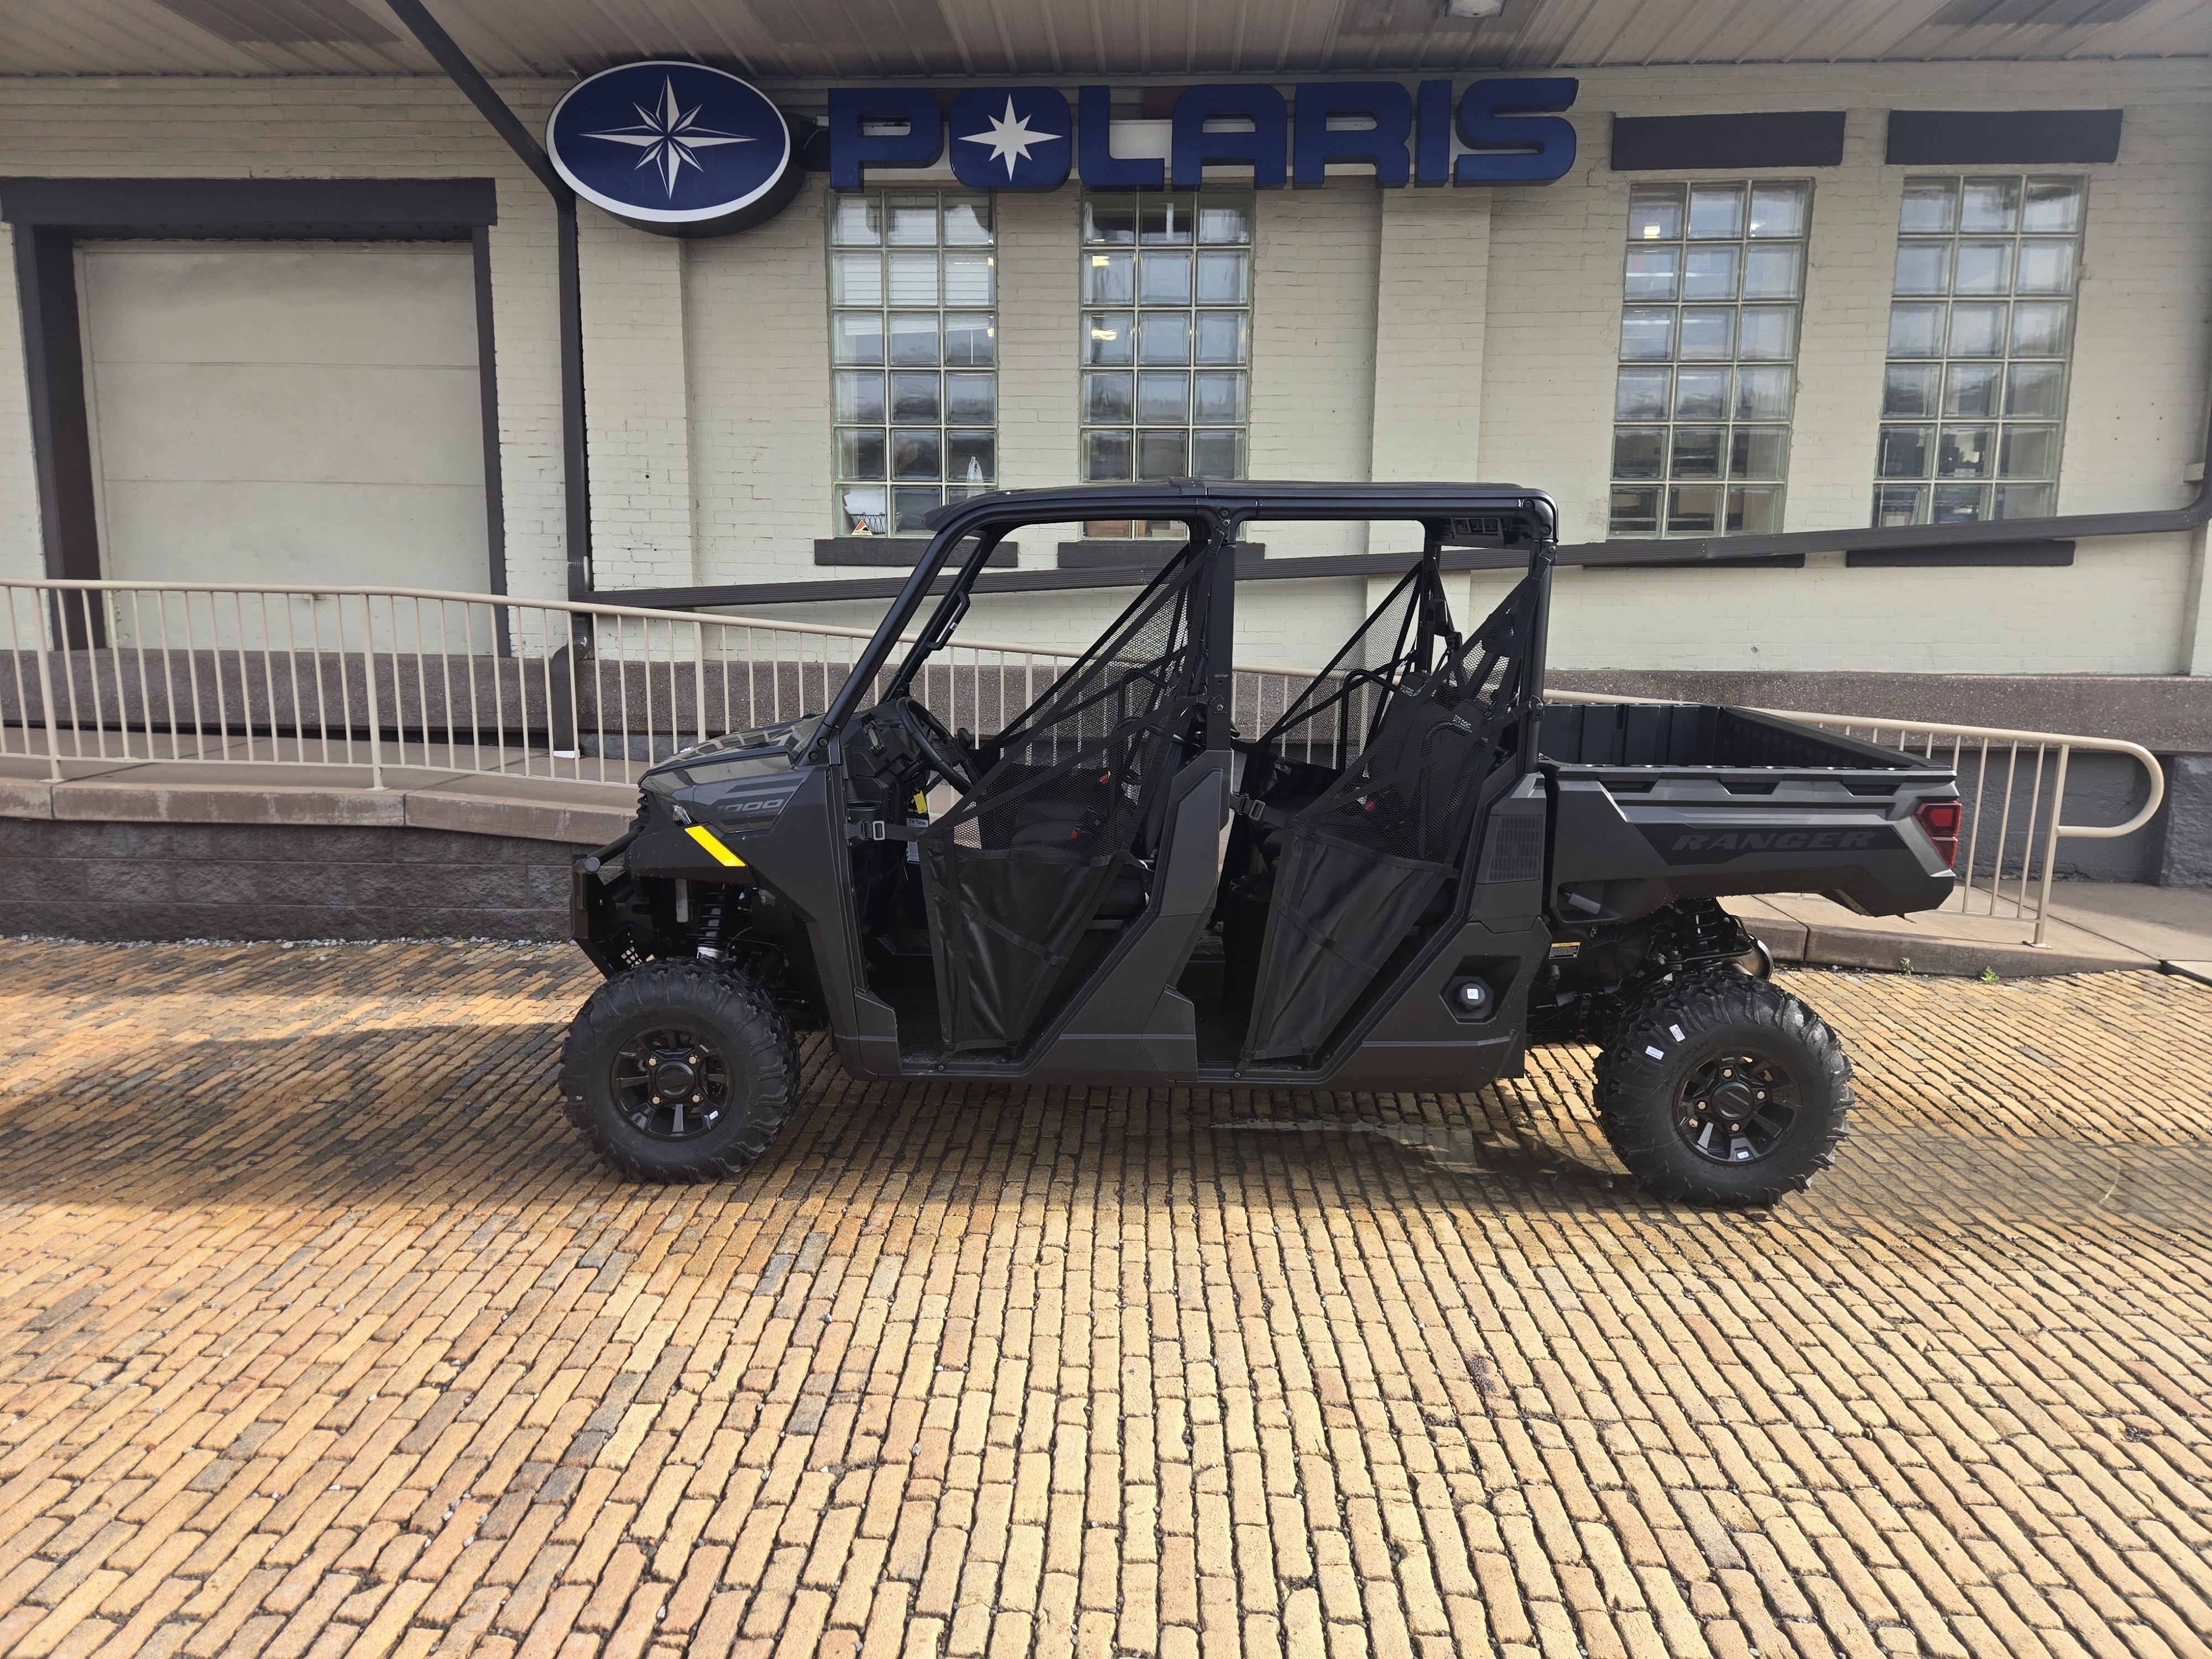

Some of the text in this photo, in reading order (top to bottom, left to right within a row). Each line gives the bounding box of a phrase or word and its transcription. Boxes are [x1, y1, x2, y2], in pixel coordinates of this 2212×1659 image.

[828, 77, 1577, 188] POLARIS
[714, 799, 784, 813] 1000
[1671, 832, 1876, 850] RANGER
